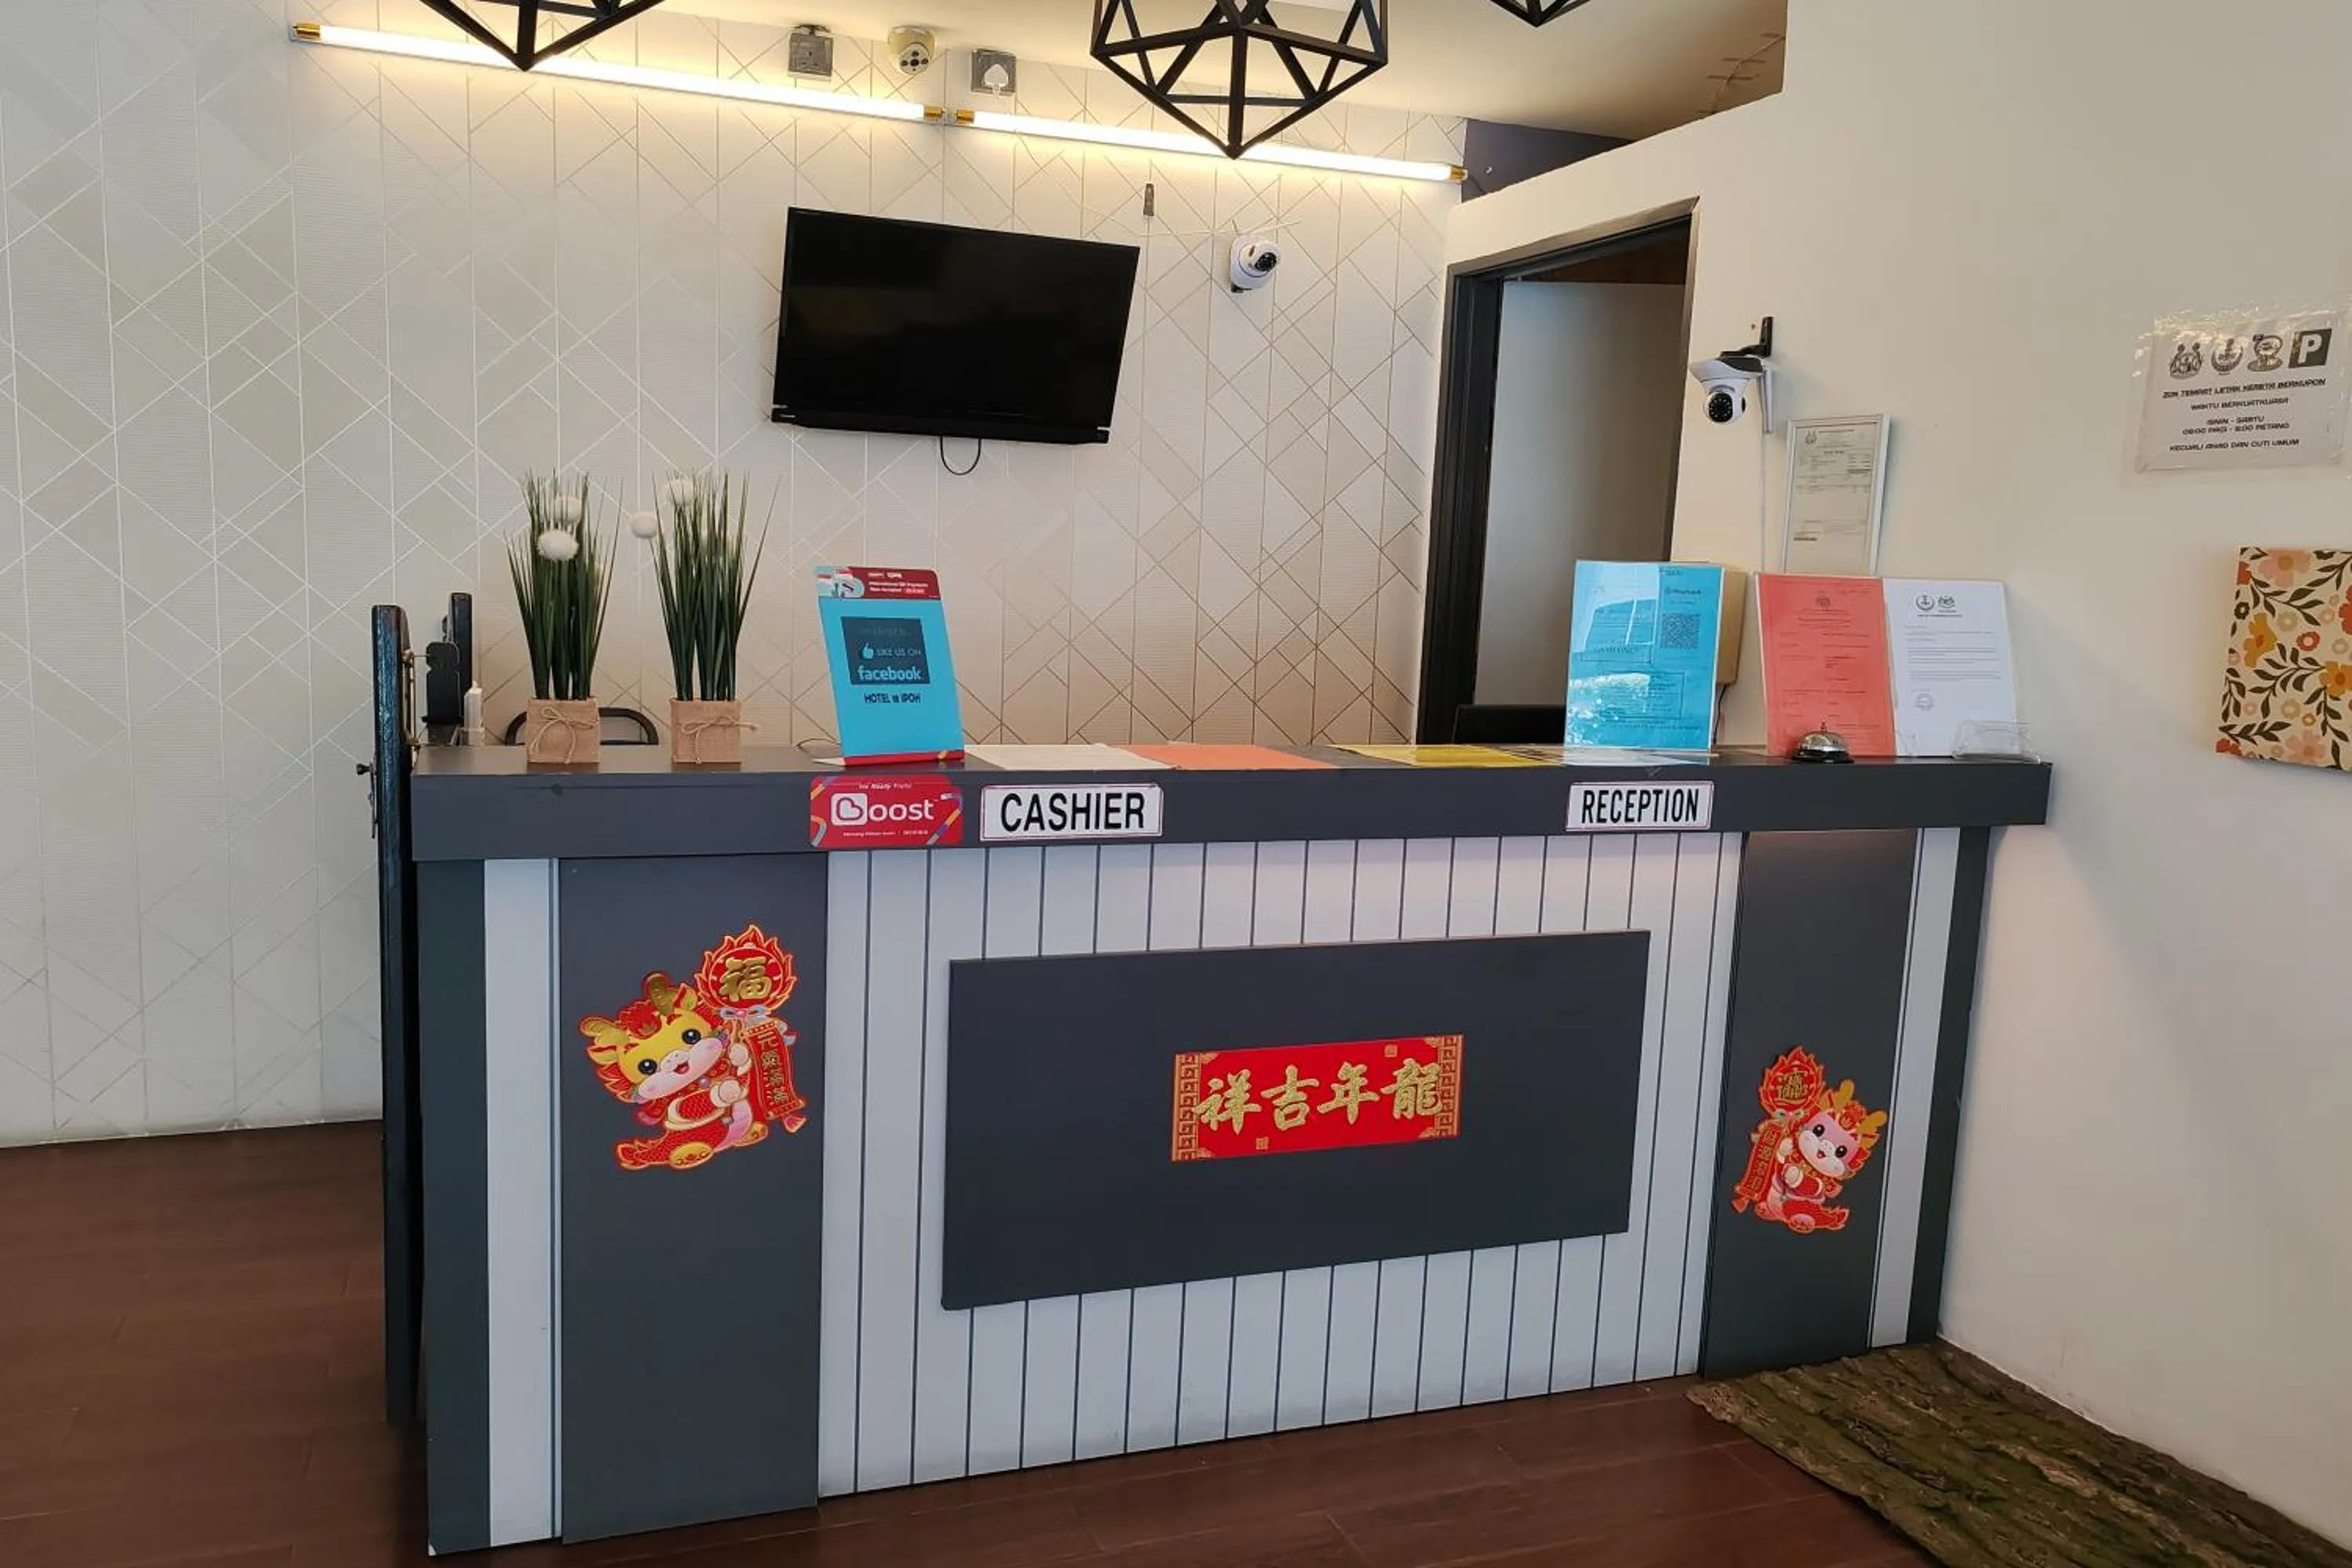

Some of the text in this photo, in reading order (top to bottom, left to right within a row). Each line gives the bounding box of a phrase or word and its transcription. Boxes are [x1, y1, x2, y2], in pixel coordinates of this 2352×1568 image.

[2298, 333, 2323, 364] P
[2278, 378, 2325, 389] BERKUPON
[857, 665, 921, 681] facebook
[864, 692, 891, 703] HOTEL
[833, 793, 935, 826] Boost
[1000, 791, 1145, 833] CASHIER
[1581, 789, 1700, 824] RECEPTION
[719, 956, 772, 1002] 福
